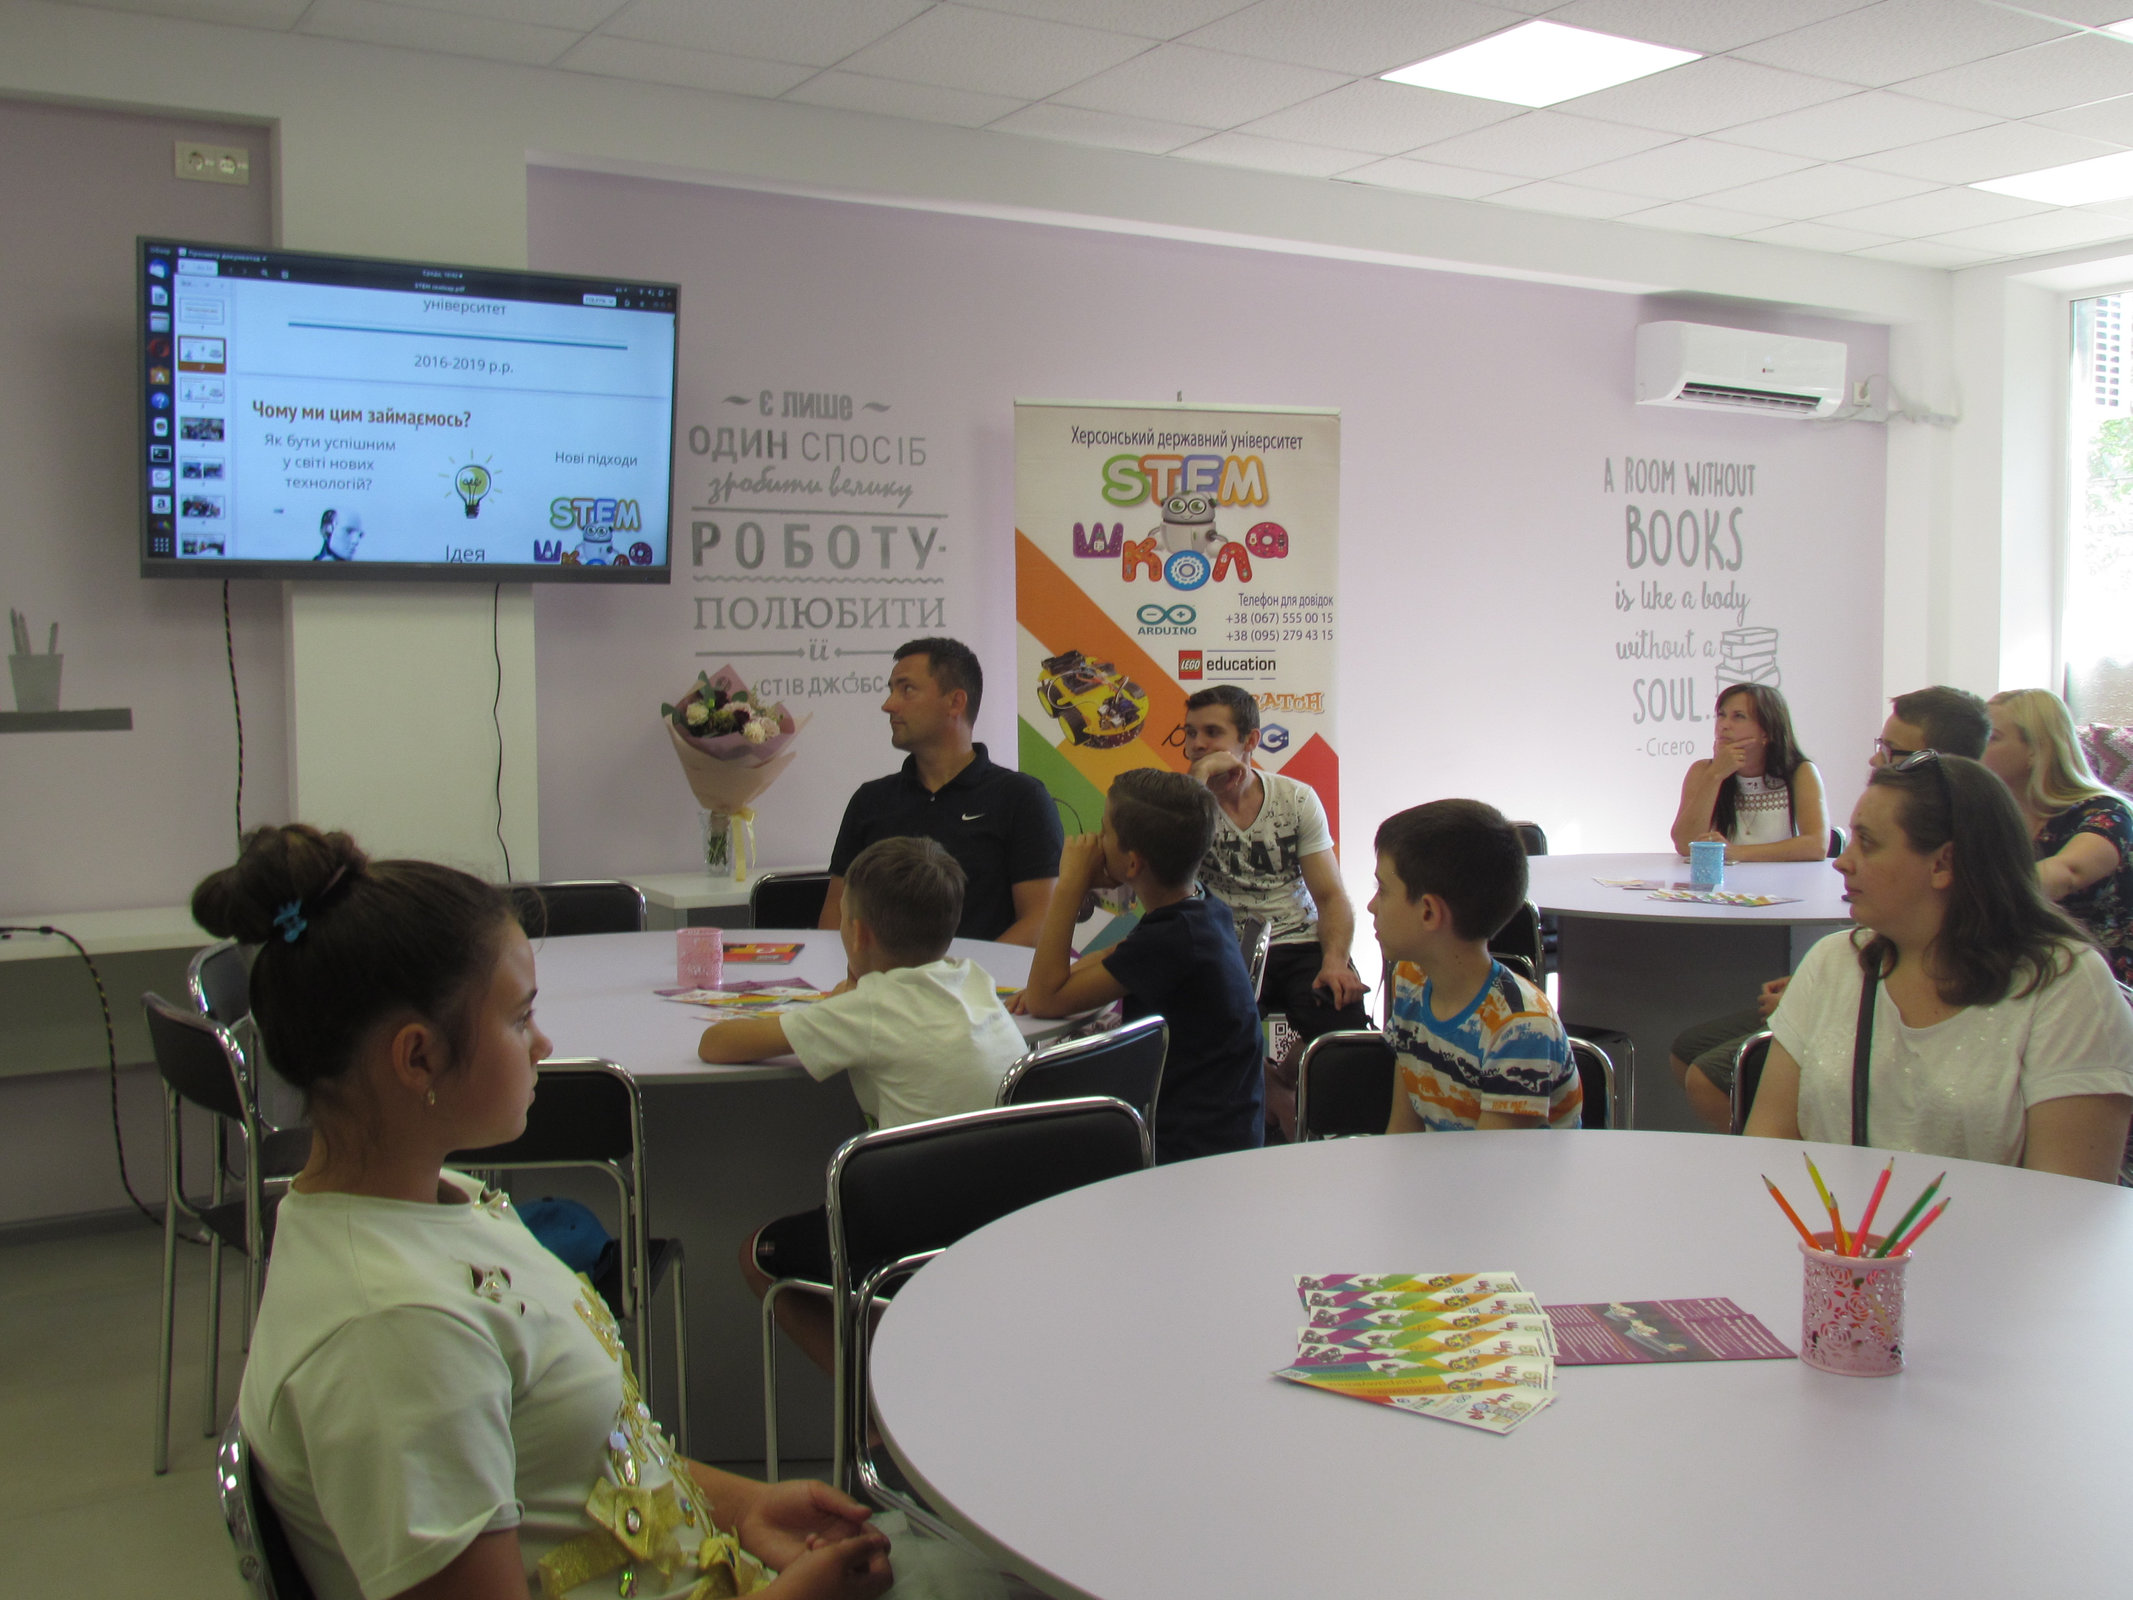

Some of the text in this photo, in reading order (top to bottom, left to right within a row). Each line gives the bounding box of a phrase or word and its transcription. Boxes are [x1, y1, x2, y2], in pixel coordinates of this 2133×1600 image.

[423, 297, 507, 316] університет
[414, 355, 514, 375] 2016-2019 р.р.
[253, 400, 471, 427] Чому ми цим займаємось?
[264, 434, 396, 451] Як бути успішним
[688, 424, 927, 466] ОДИН СПОСІБ
[1071, 425, 1303, 453] Херсонський державний університет
[282, 457, 375, 471] у світі нових
[555, 451, 638, 468] Нові підходи
[286, 476, 372, 491] технологій?
[1101, 453, 1269, 507] STEM
[1604, 456, 1756, 497] A ROOM WITHOUT
[707, 465, 913, 509] зробити велику
[550, 497, 641, 531] STEM
[1625, 504, 1743, 572] BOOKS
[445, 544, 485, 563] Ідея
[1238, 592, 1334, 609] Телефон для довідок
[1615, 580, 1751, 627] is like a body
[693, 596, 947, 631] ПОЛЮБИТИ
[1226, 612, 1333, 625] +38 (067) 555 00 15
[1137, 626, 1197, 636] ARDUINO
[1226, 629, 1333, 643] +38 (095) 279 43 15
[1615, 629, 1717, 660] without a
[1180, 656, 1276, 672] LEGO education
[760, 678, 804, 696] СТІВ
[1646, 737, 1695, 757] Cicero
